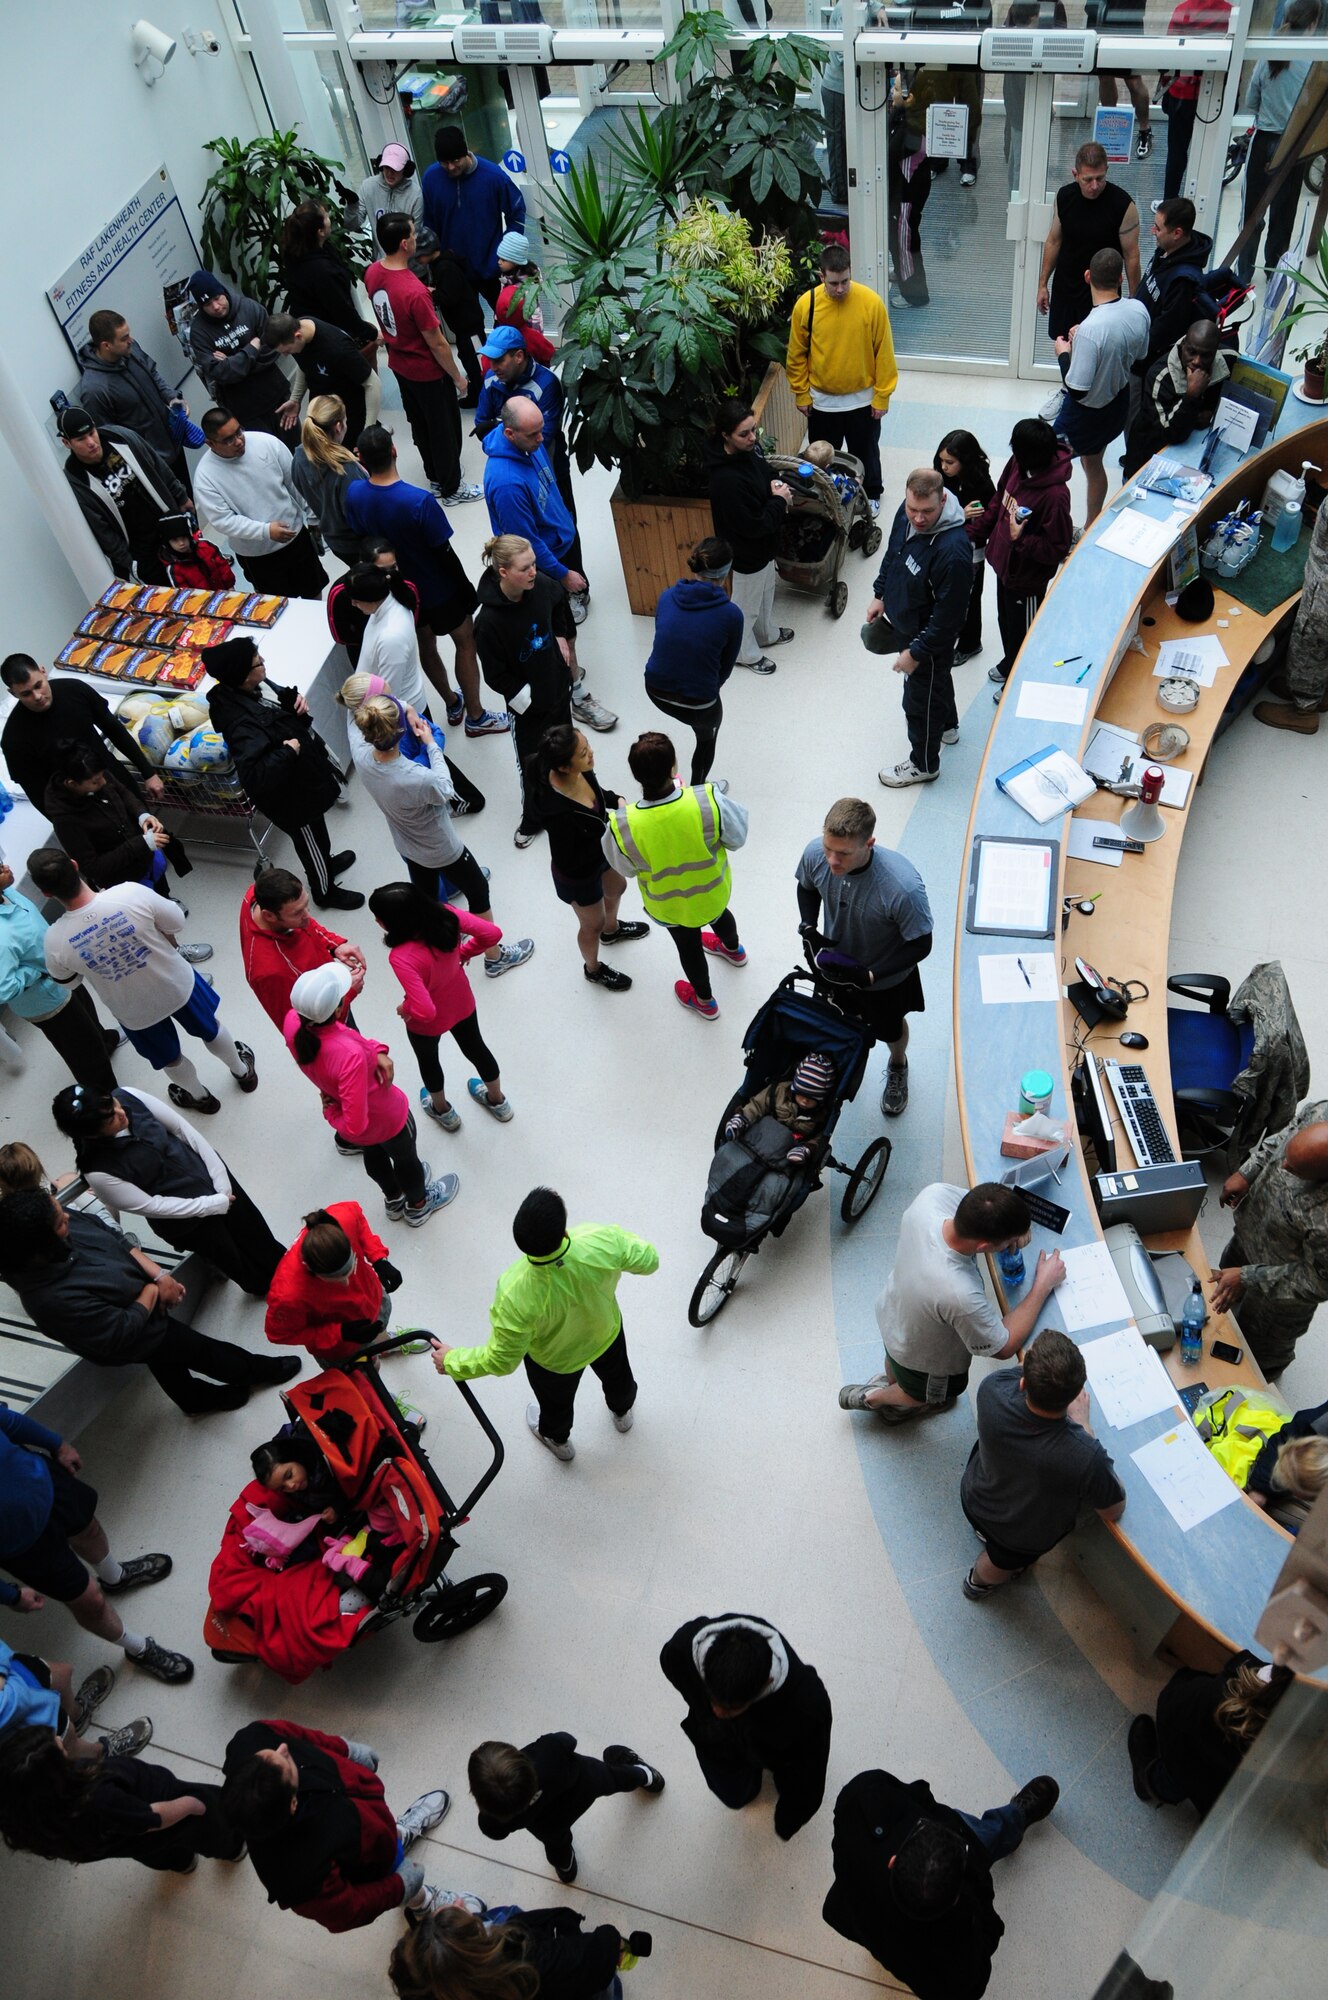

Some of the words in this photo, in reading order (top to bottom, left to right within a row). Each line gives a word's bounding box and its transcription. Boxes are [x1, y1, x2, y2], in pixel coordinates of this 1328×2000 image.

[940, 8, 962, 19] PUMA
[65, 270, 97, 310] FITNESS
[96, 252, 113, 276] AND
[111, 222, 139, 258] HEALTH
[138, 192, 167, 227] CENTER
[80, 246, 96, 269] RAF
[95, 197, 141, 252] LAKENHEATH
